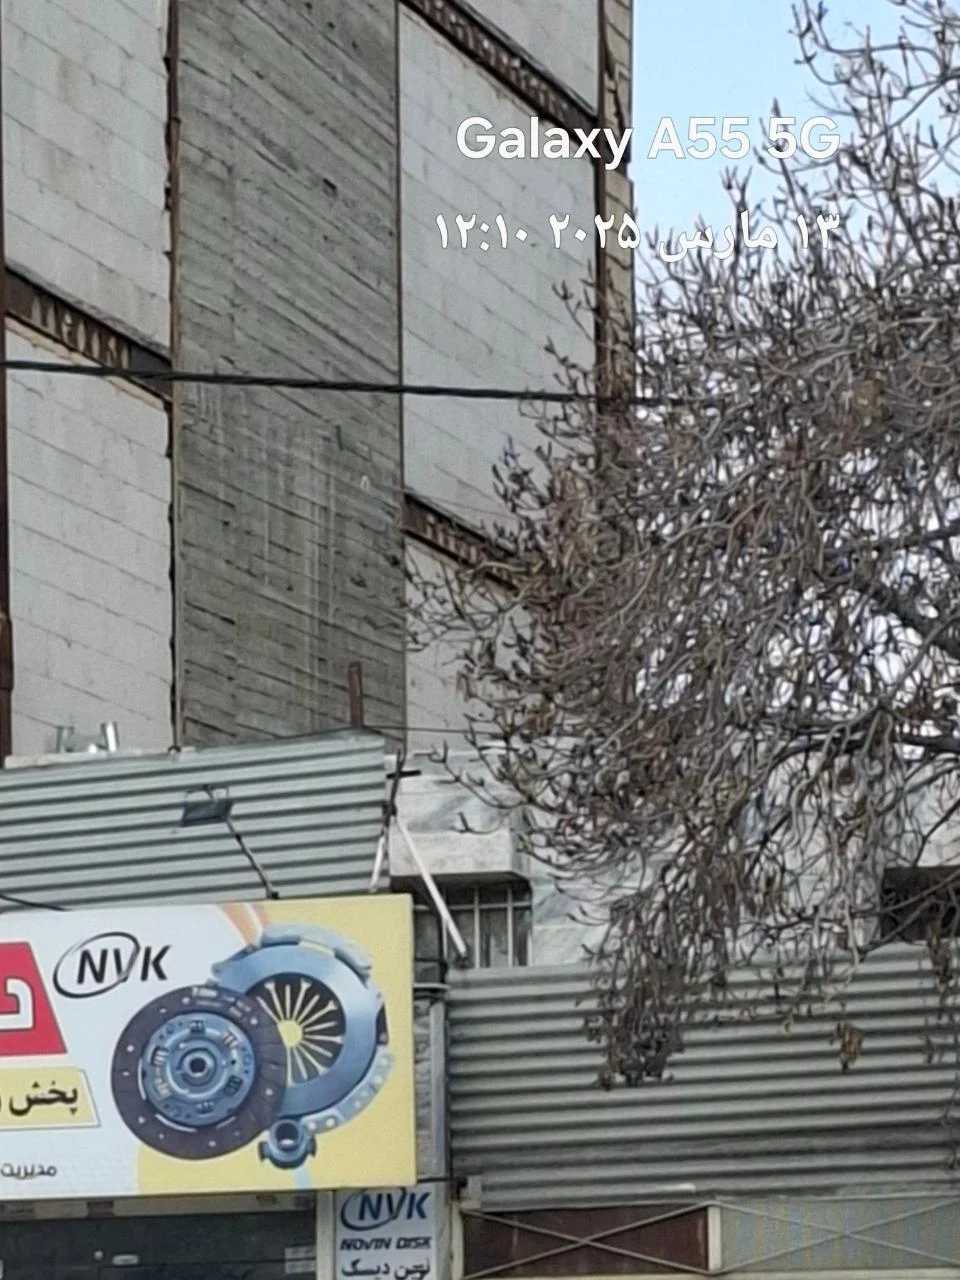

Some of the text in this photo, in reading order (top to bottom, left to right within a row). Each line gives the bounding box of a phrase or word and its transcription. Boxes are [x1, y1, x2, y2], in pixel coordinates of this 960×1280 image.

[76, 938, 172, 985] NVK
[9, 1080, 78, 1116] پخش
[0, 1163, 57, 1180] مدیریت
[357, 1188, 431, 1221] NVK
[340, 1236, 432, 1251] NOVIN DISK
[341, 1258, 390, 1280] دیسک
